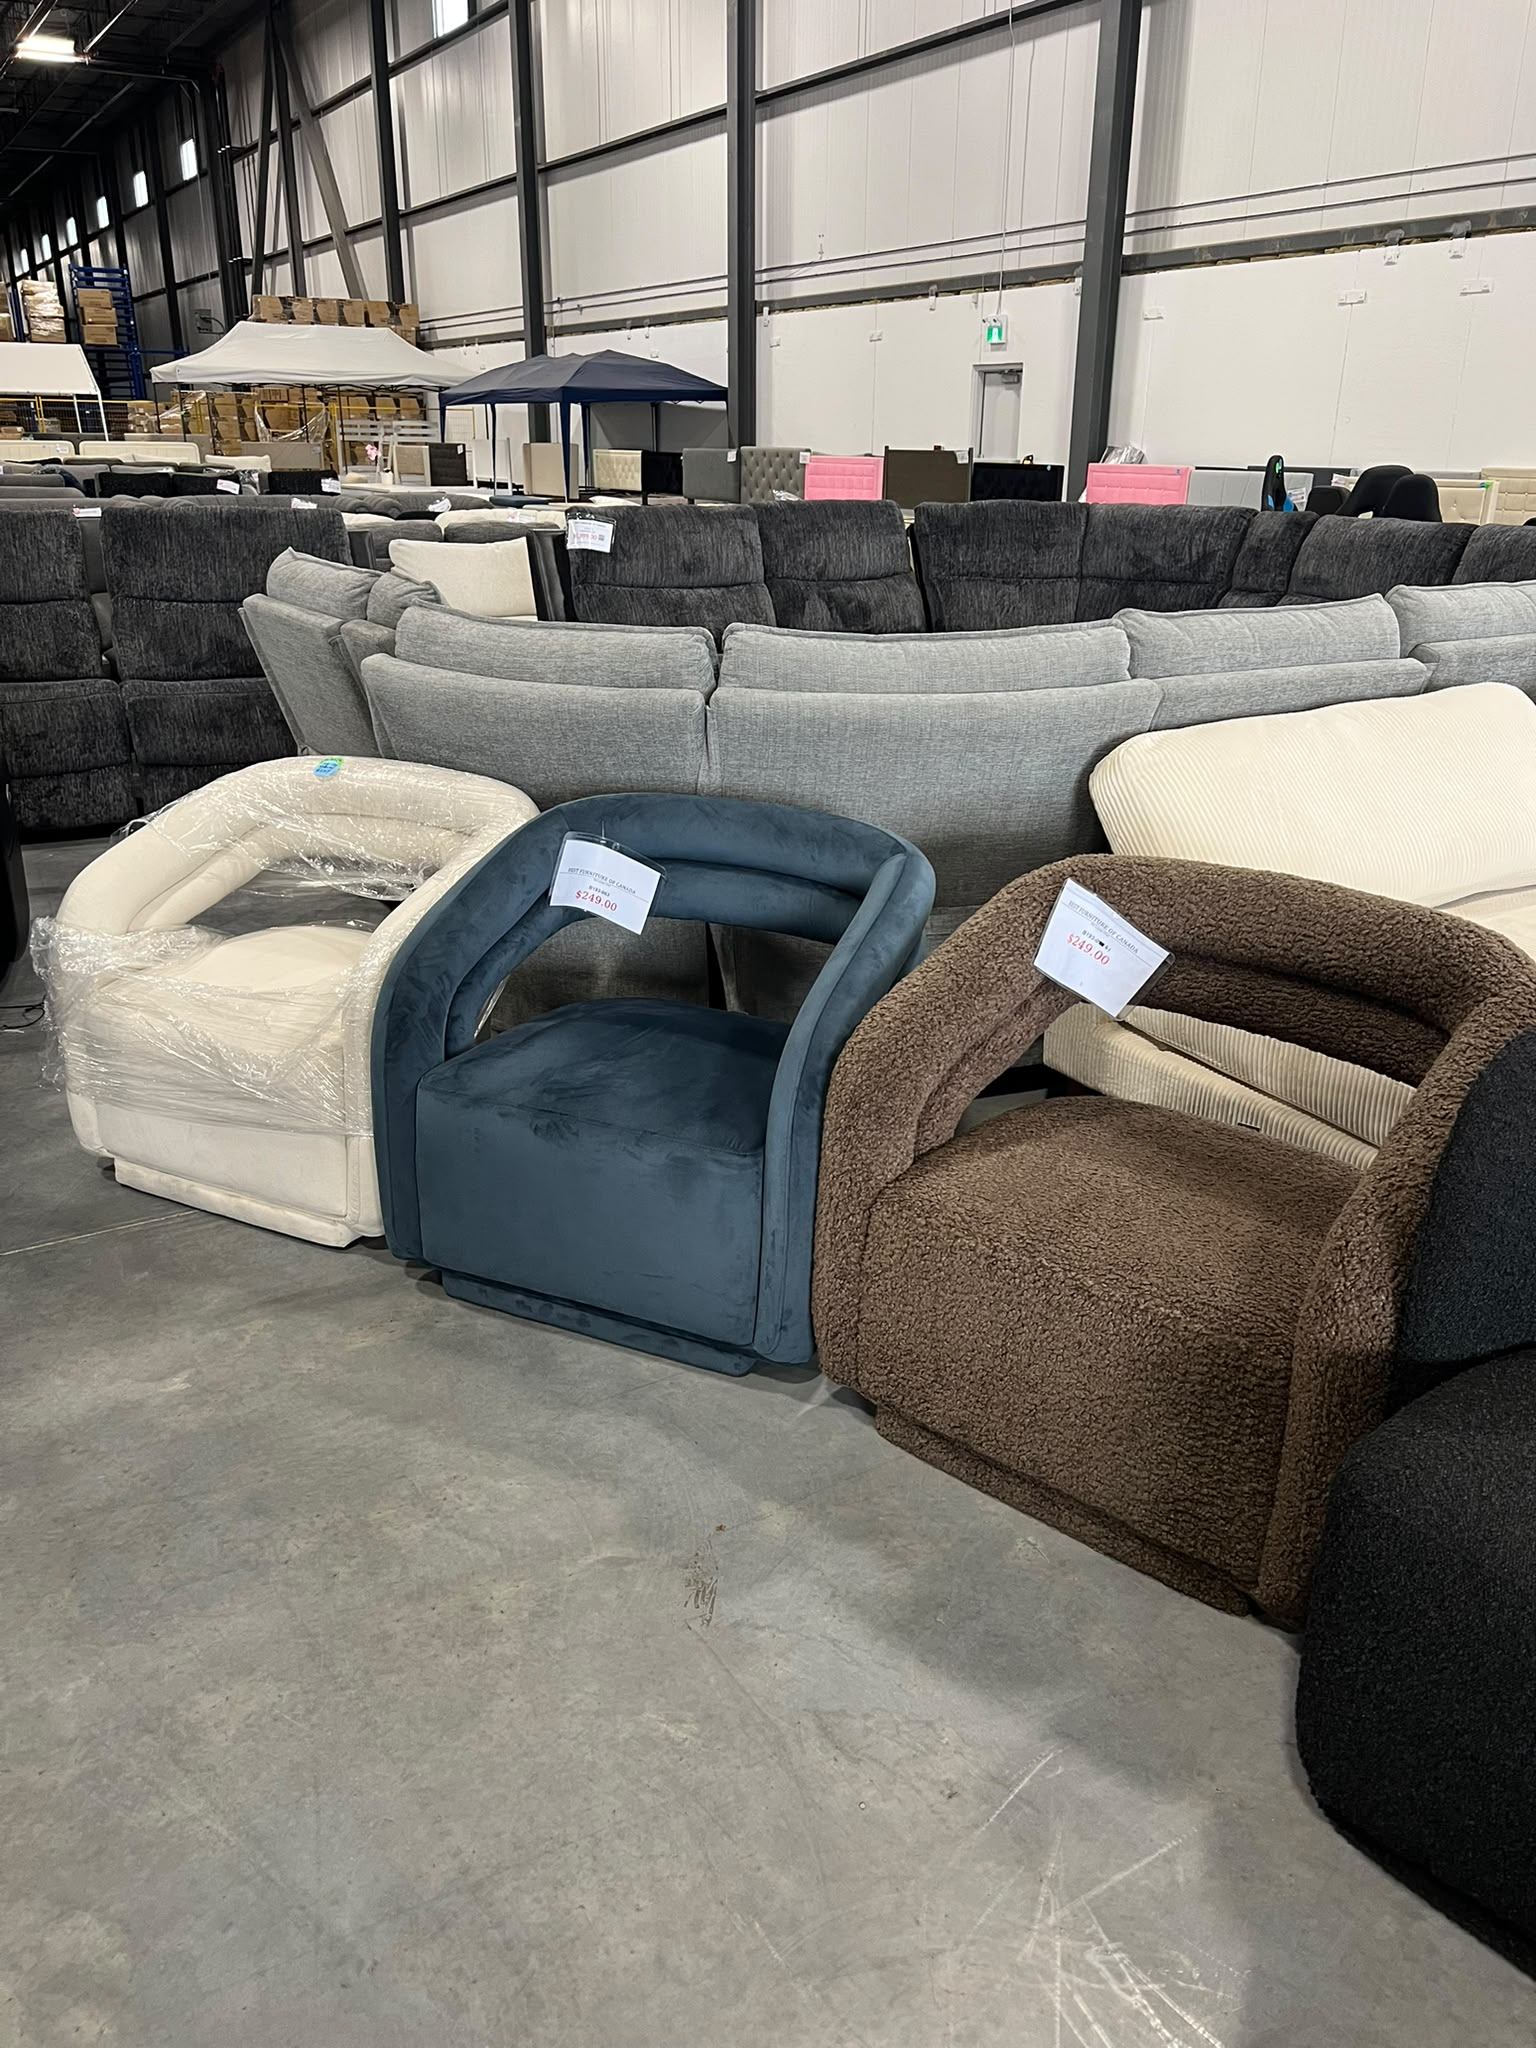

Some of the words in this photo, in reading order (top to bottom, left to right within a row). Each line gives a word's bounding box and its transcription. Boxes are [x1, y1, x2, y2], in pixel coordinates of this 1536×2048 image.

[580, 869, 608, 881] FURNITURE
[616, 881, 636, 894] CANADA
[576, 890, 618, 912] $249.00
[1080, 907, 1109, 929] FURNITURE
[1108, 928, 1117, 936] OF
[1116, 934, 1139, 954] CANADA
[1067, 933, 1110, 965] $249.00
